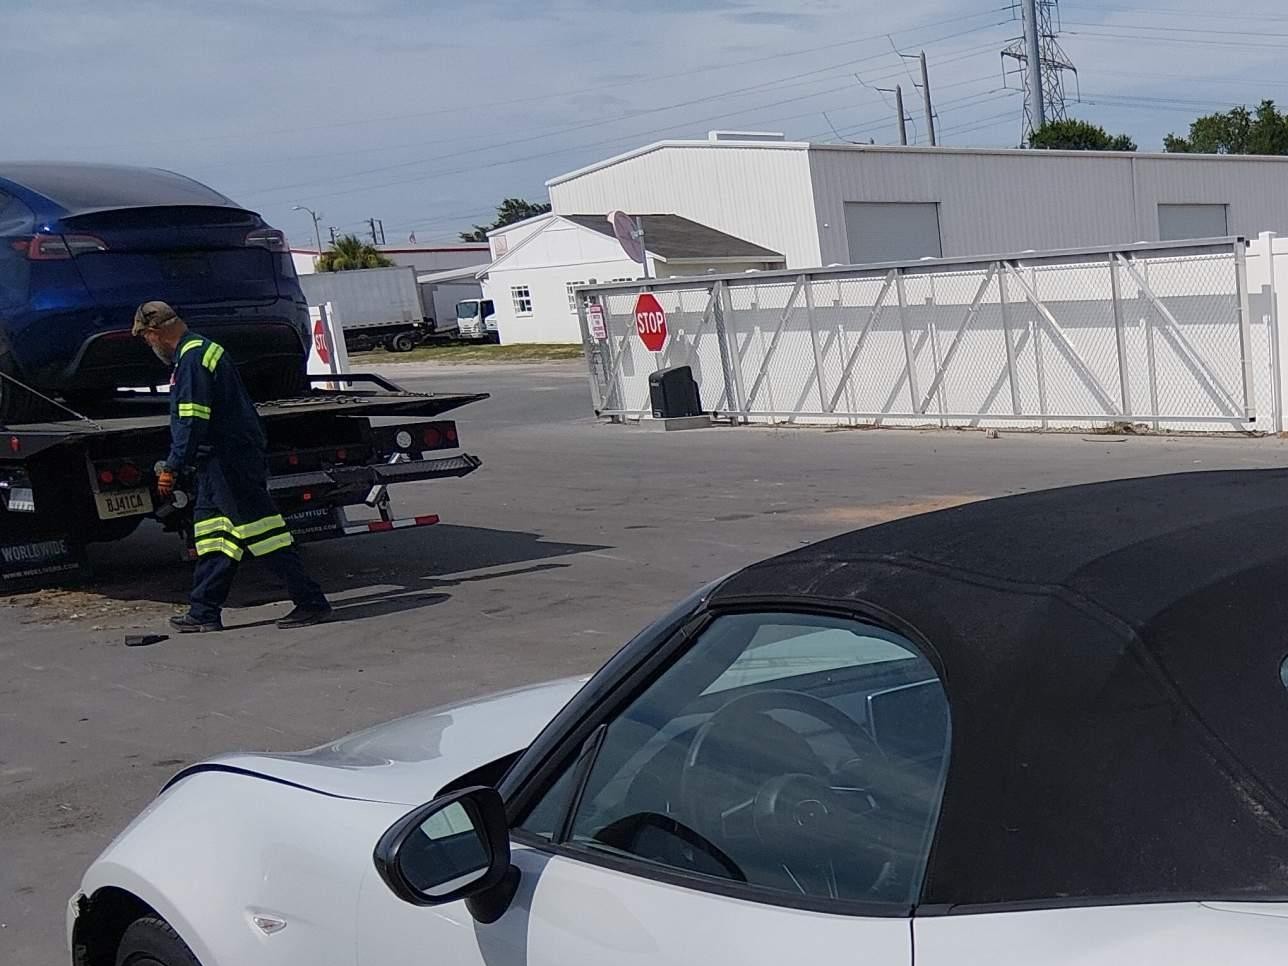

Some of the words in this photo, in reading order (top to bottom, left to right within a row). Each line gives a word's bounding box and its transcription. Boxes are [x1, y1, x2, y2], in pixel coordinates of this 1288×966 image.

[637, 311, 664, 334] STOP
[315, 333, 328, 352] ST
[1, 539, 67, 561] WORLDWIDE
